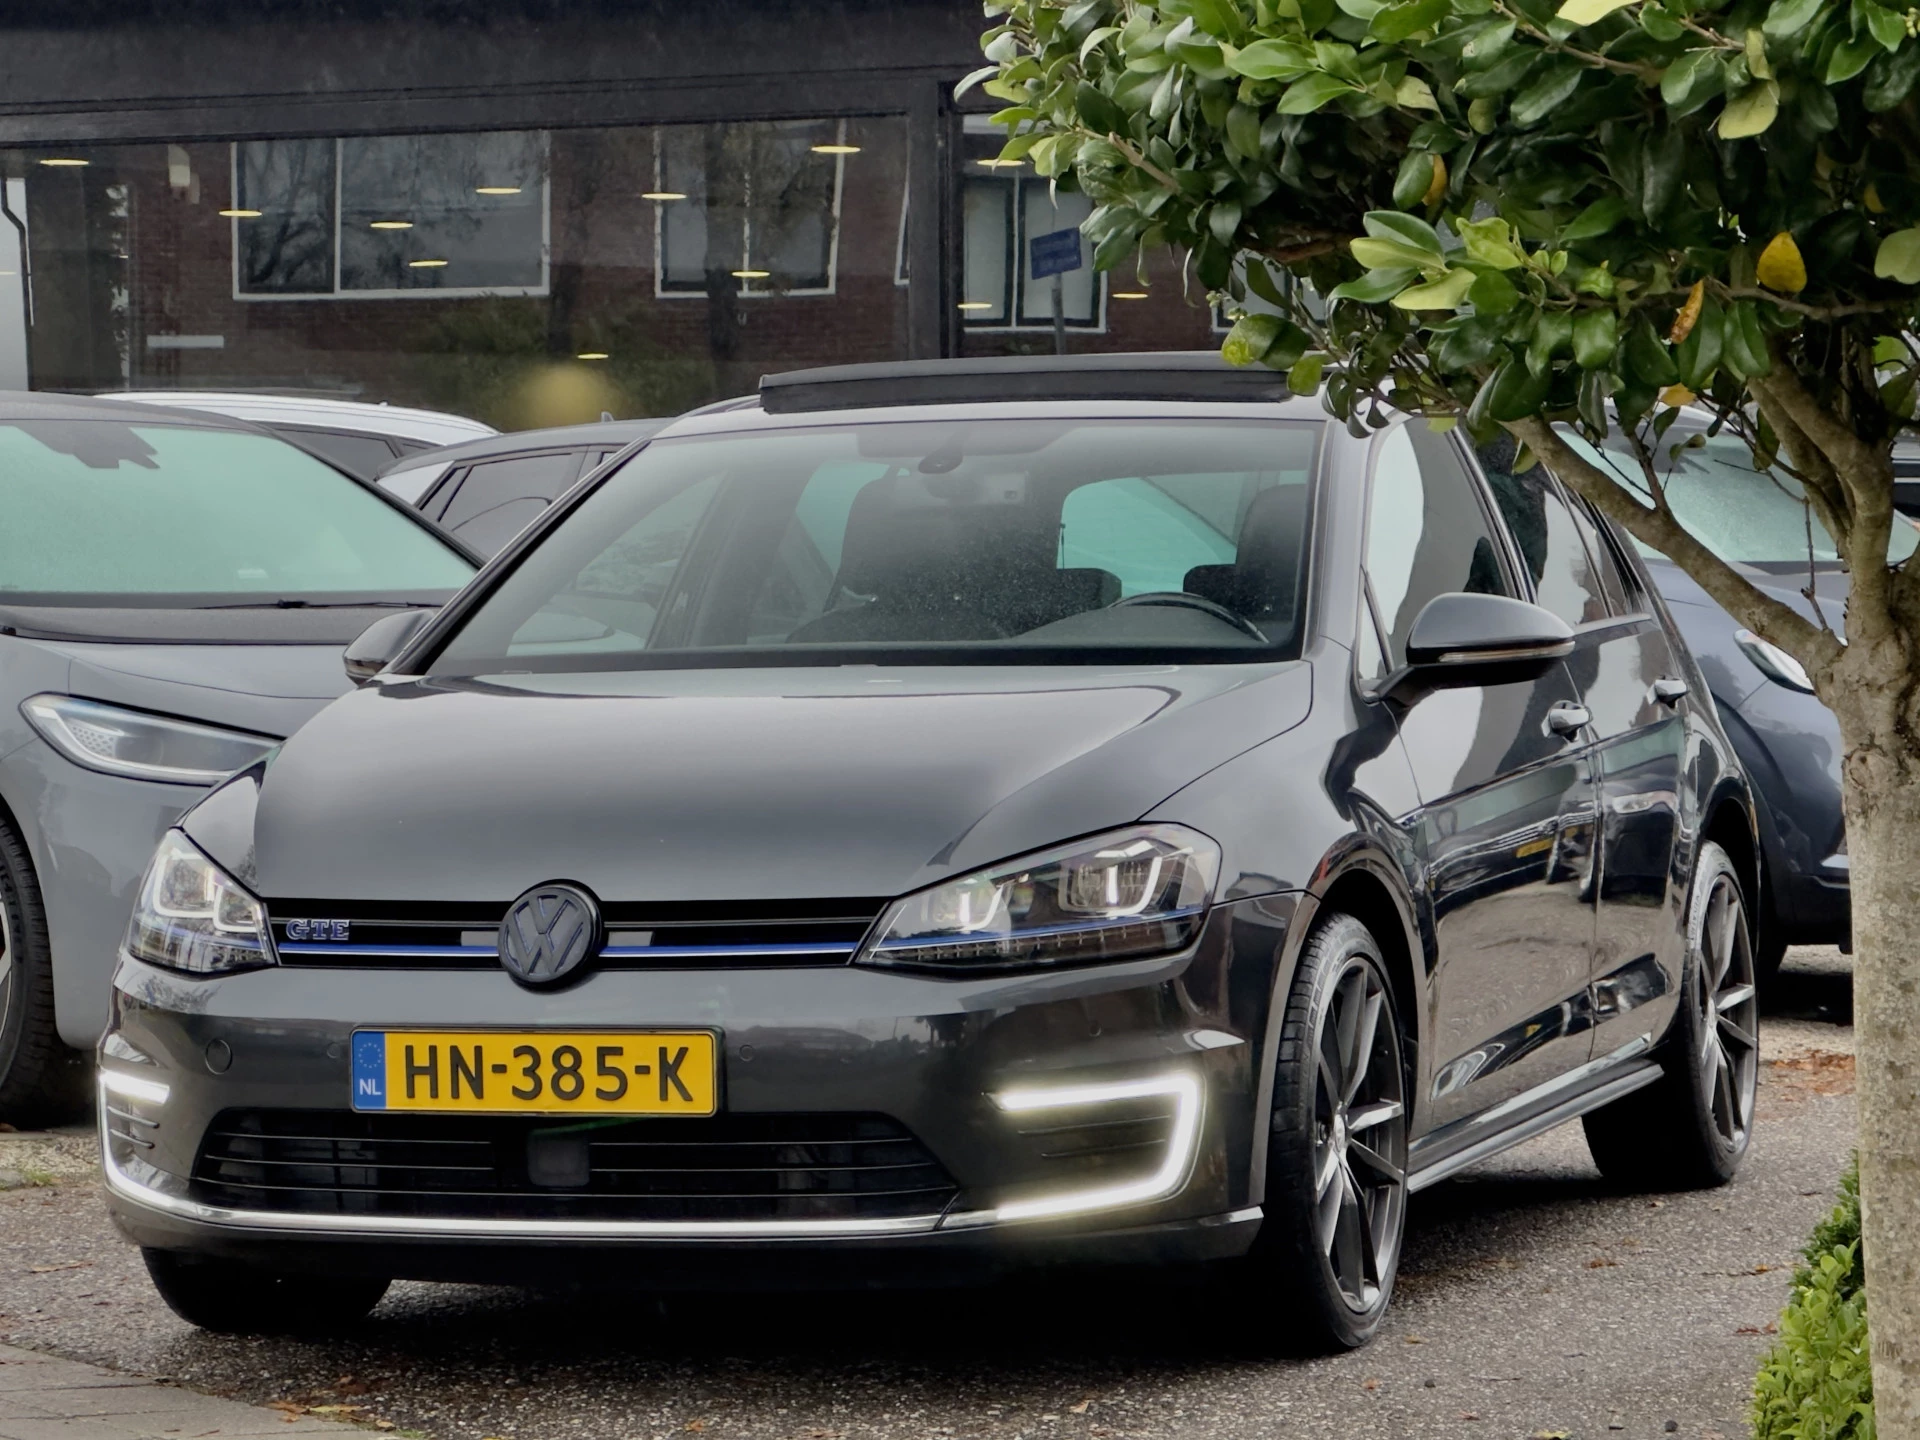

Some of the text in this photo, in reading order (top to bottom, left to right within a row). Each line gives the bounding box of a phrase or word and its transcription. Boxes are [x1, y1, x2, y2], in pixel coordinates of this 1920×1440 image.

[286, 919, 350, 940] GTE
[503, 889, 590, 979] VW
[359, 1078, 382, 1096] NL
[404, 1044, 693, 1102] HN-385-K
